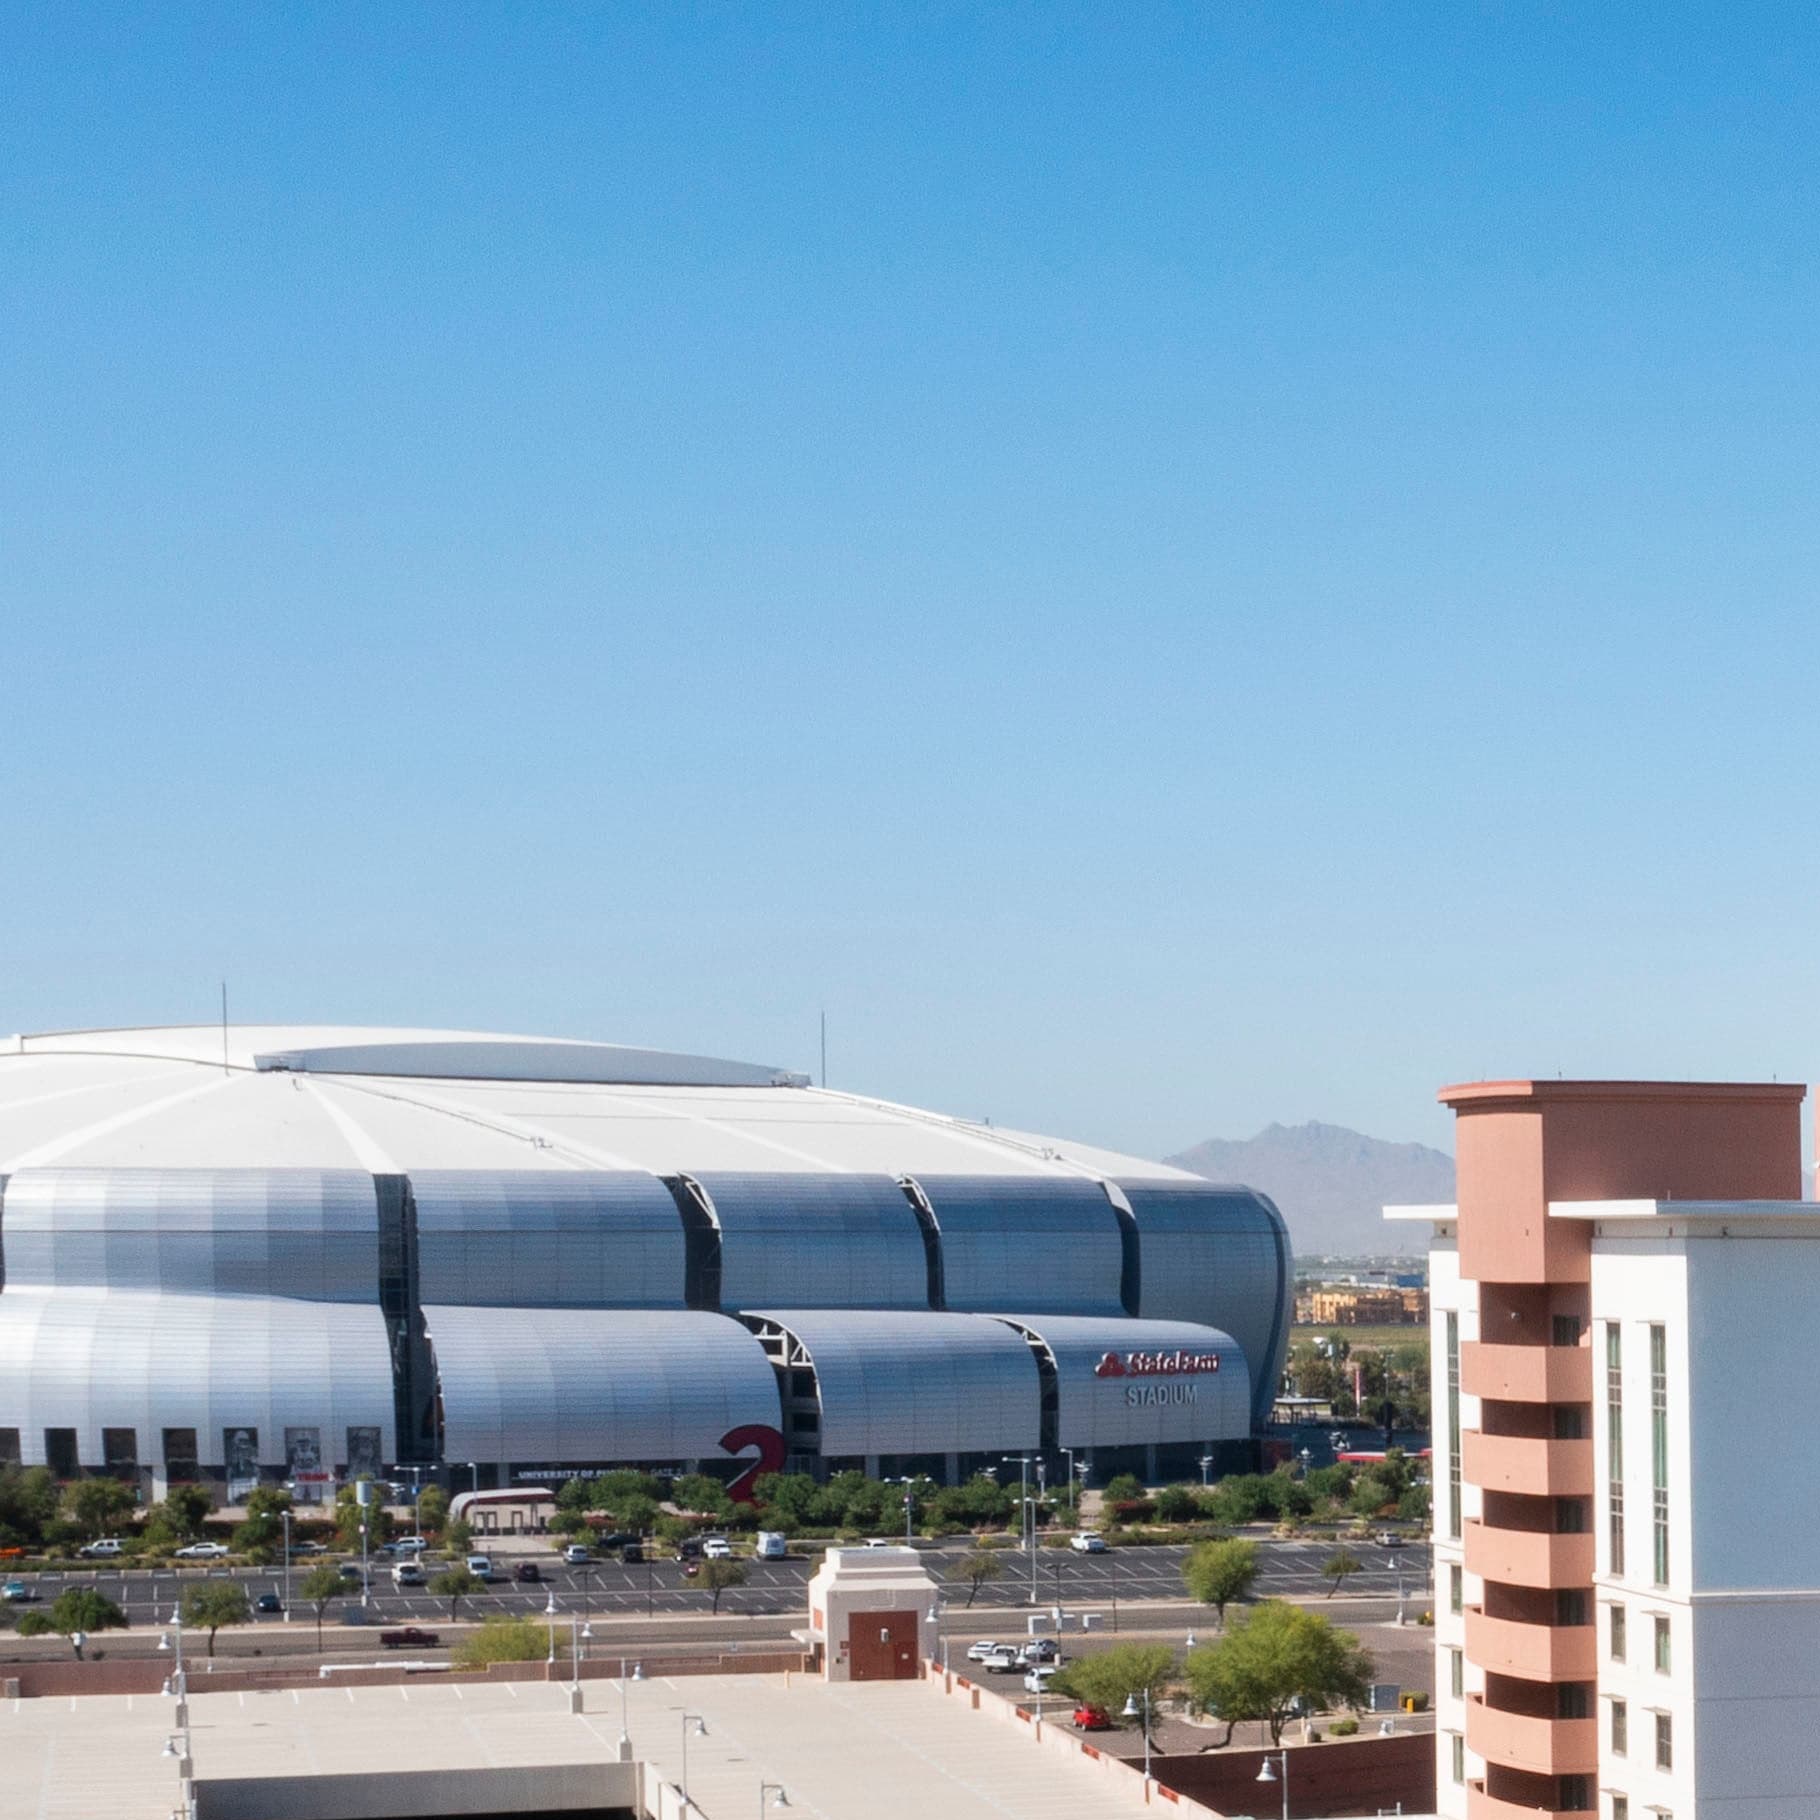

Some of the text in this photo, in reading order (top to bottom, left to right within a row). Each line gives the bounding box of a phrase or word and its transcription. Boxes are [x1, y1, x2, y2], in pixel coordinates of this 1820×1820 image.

[1127, 1383, 1198, 1407] STADIUM
[518, 1469, 578, 1480] UNIVERSITY
[718, 1424, 788, 1510] 2
